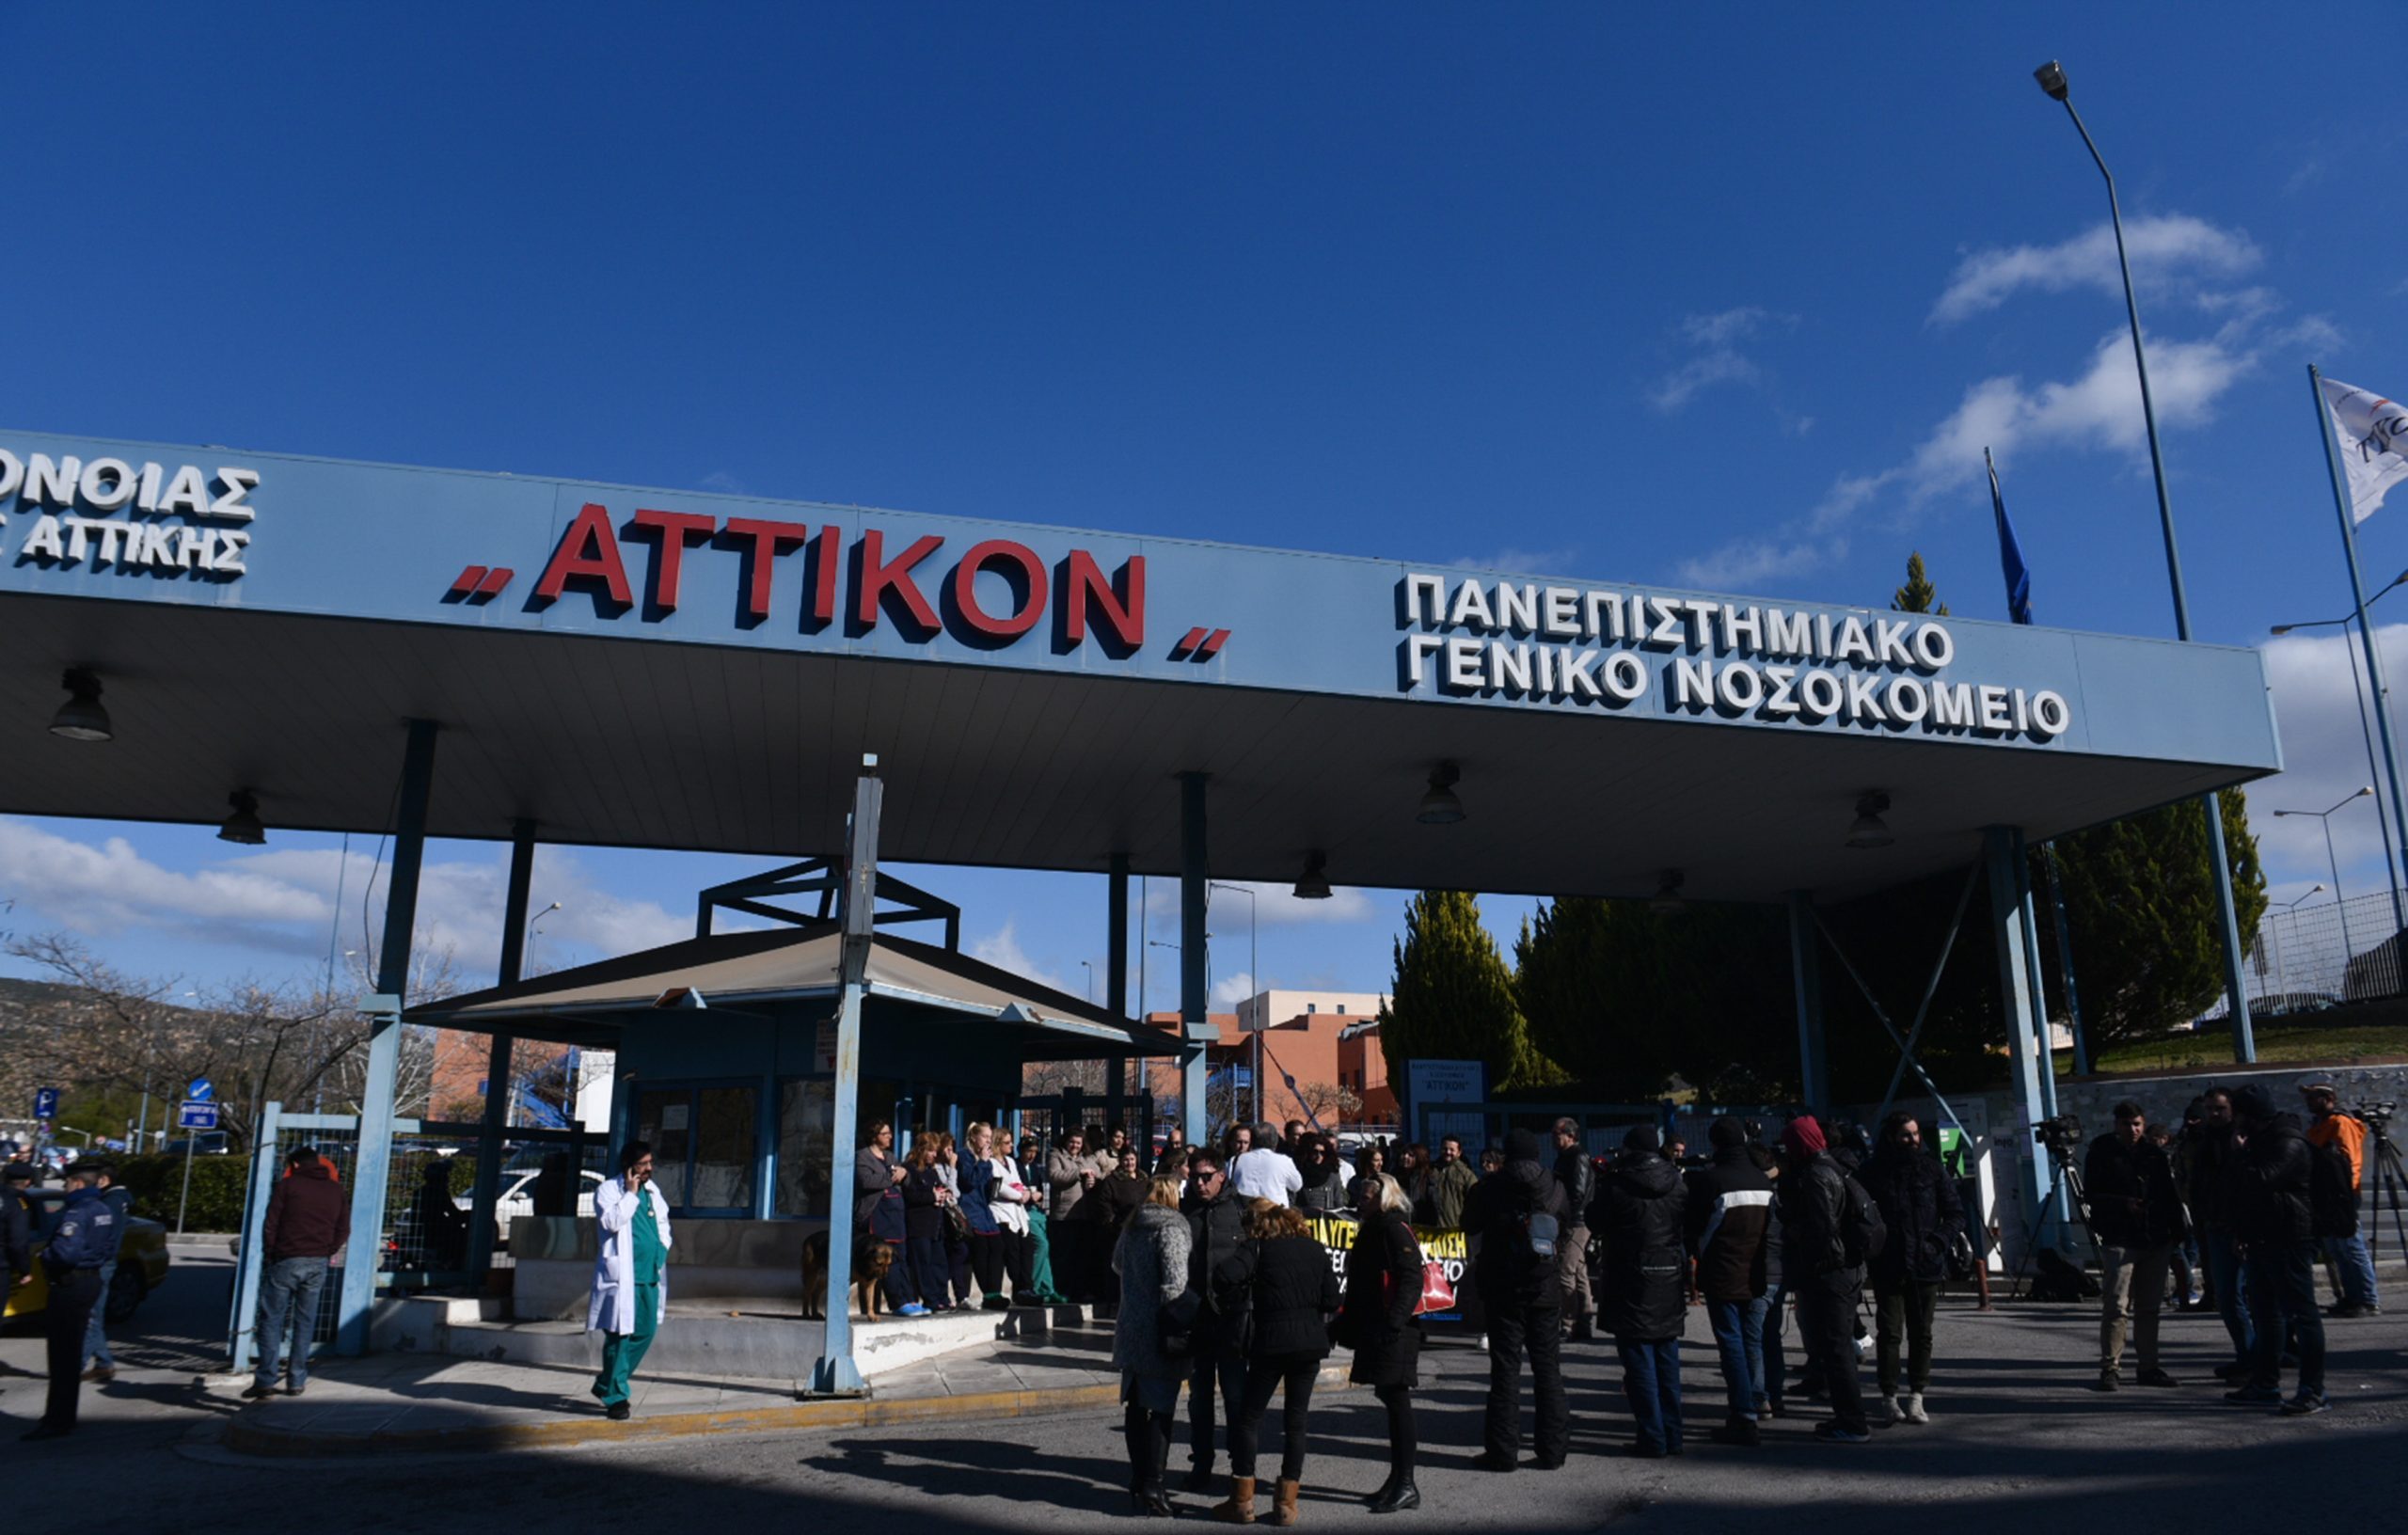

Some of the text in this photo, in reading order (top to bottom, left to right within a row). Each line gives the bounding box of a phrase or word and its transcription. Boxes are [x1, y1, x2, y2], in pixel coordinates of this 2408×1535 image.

[23, 514, 252, 573] ΑΤΤΙΚΗΣ
[1403, 573, 1954, 670] ΠΑΝΕΠΙΣΤΗΜΙΑΚΟ
[1404, 634, 2069, 737] ΓΕΝΙΚΟ ΝΟΣΟΚΟΜΕΙΟ
